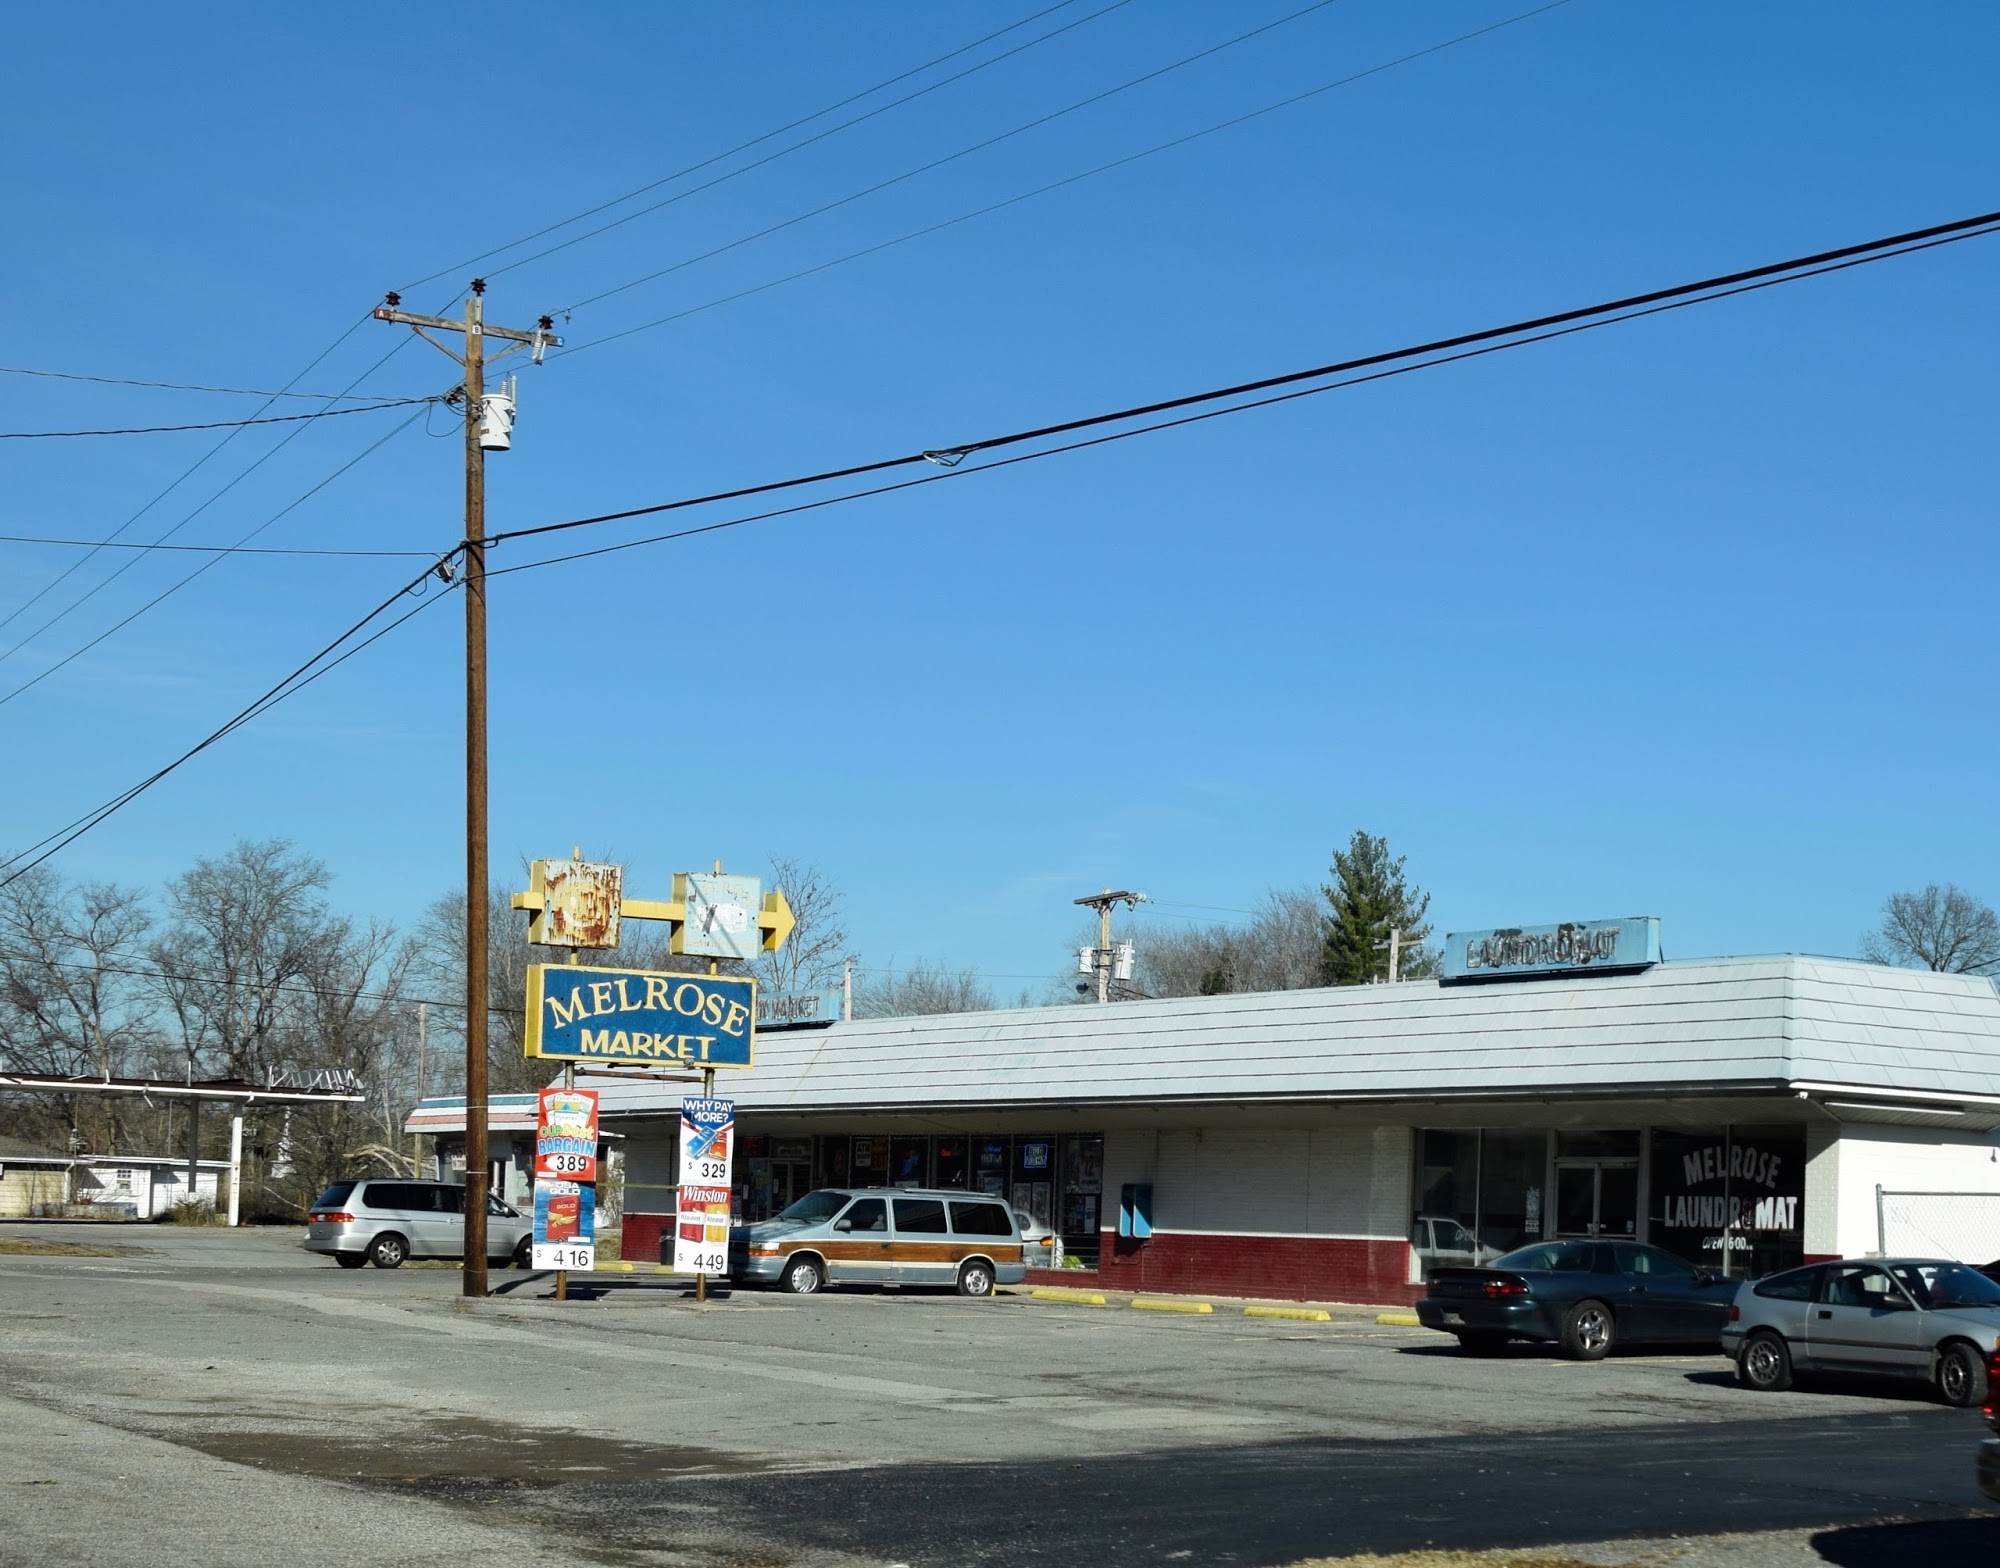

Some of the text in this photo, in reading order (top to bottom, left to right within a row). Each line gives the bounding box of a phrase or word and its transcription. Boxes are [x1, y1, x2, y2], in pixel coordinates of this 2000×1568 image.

[545, 977, 749, 1037] MELROSE
[580, 1029, 717, 1060] MARKET
[684, 1099, 733, 1113] WHY PAY
[691, 1111, 729, 1123] MORE?
[540, 1124, 563, 1137] OUR
[538, 1137, 597, 1159] BARGAIN
[1028, 1146, 1044, 1156] BUD
[1682, 1145, 1782, 1189] MELROSE
[549, 1187, 582, 1196] GOLD
[555, 1181, 580, 1189] USA
[683, 1185, 728, 1203] Winston
[1702, 1235, 1724, 1250] OPEN
